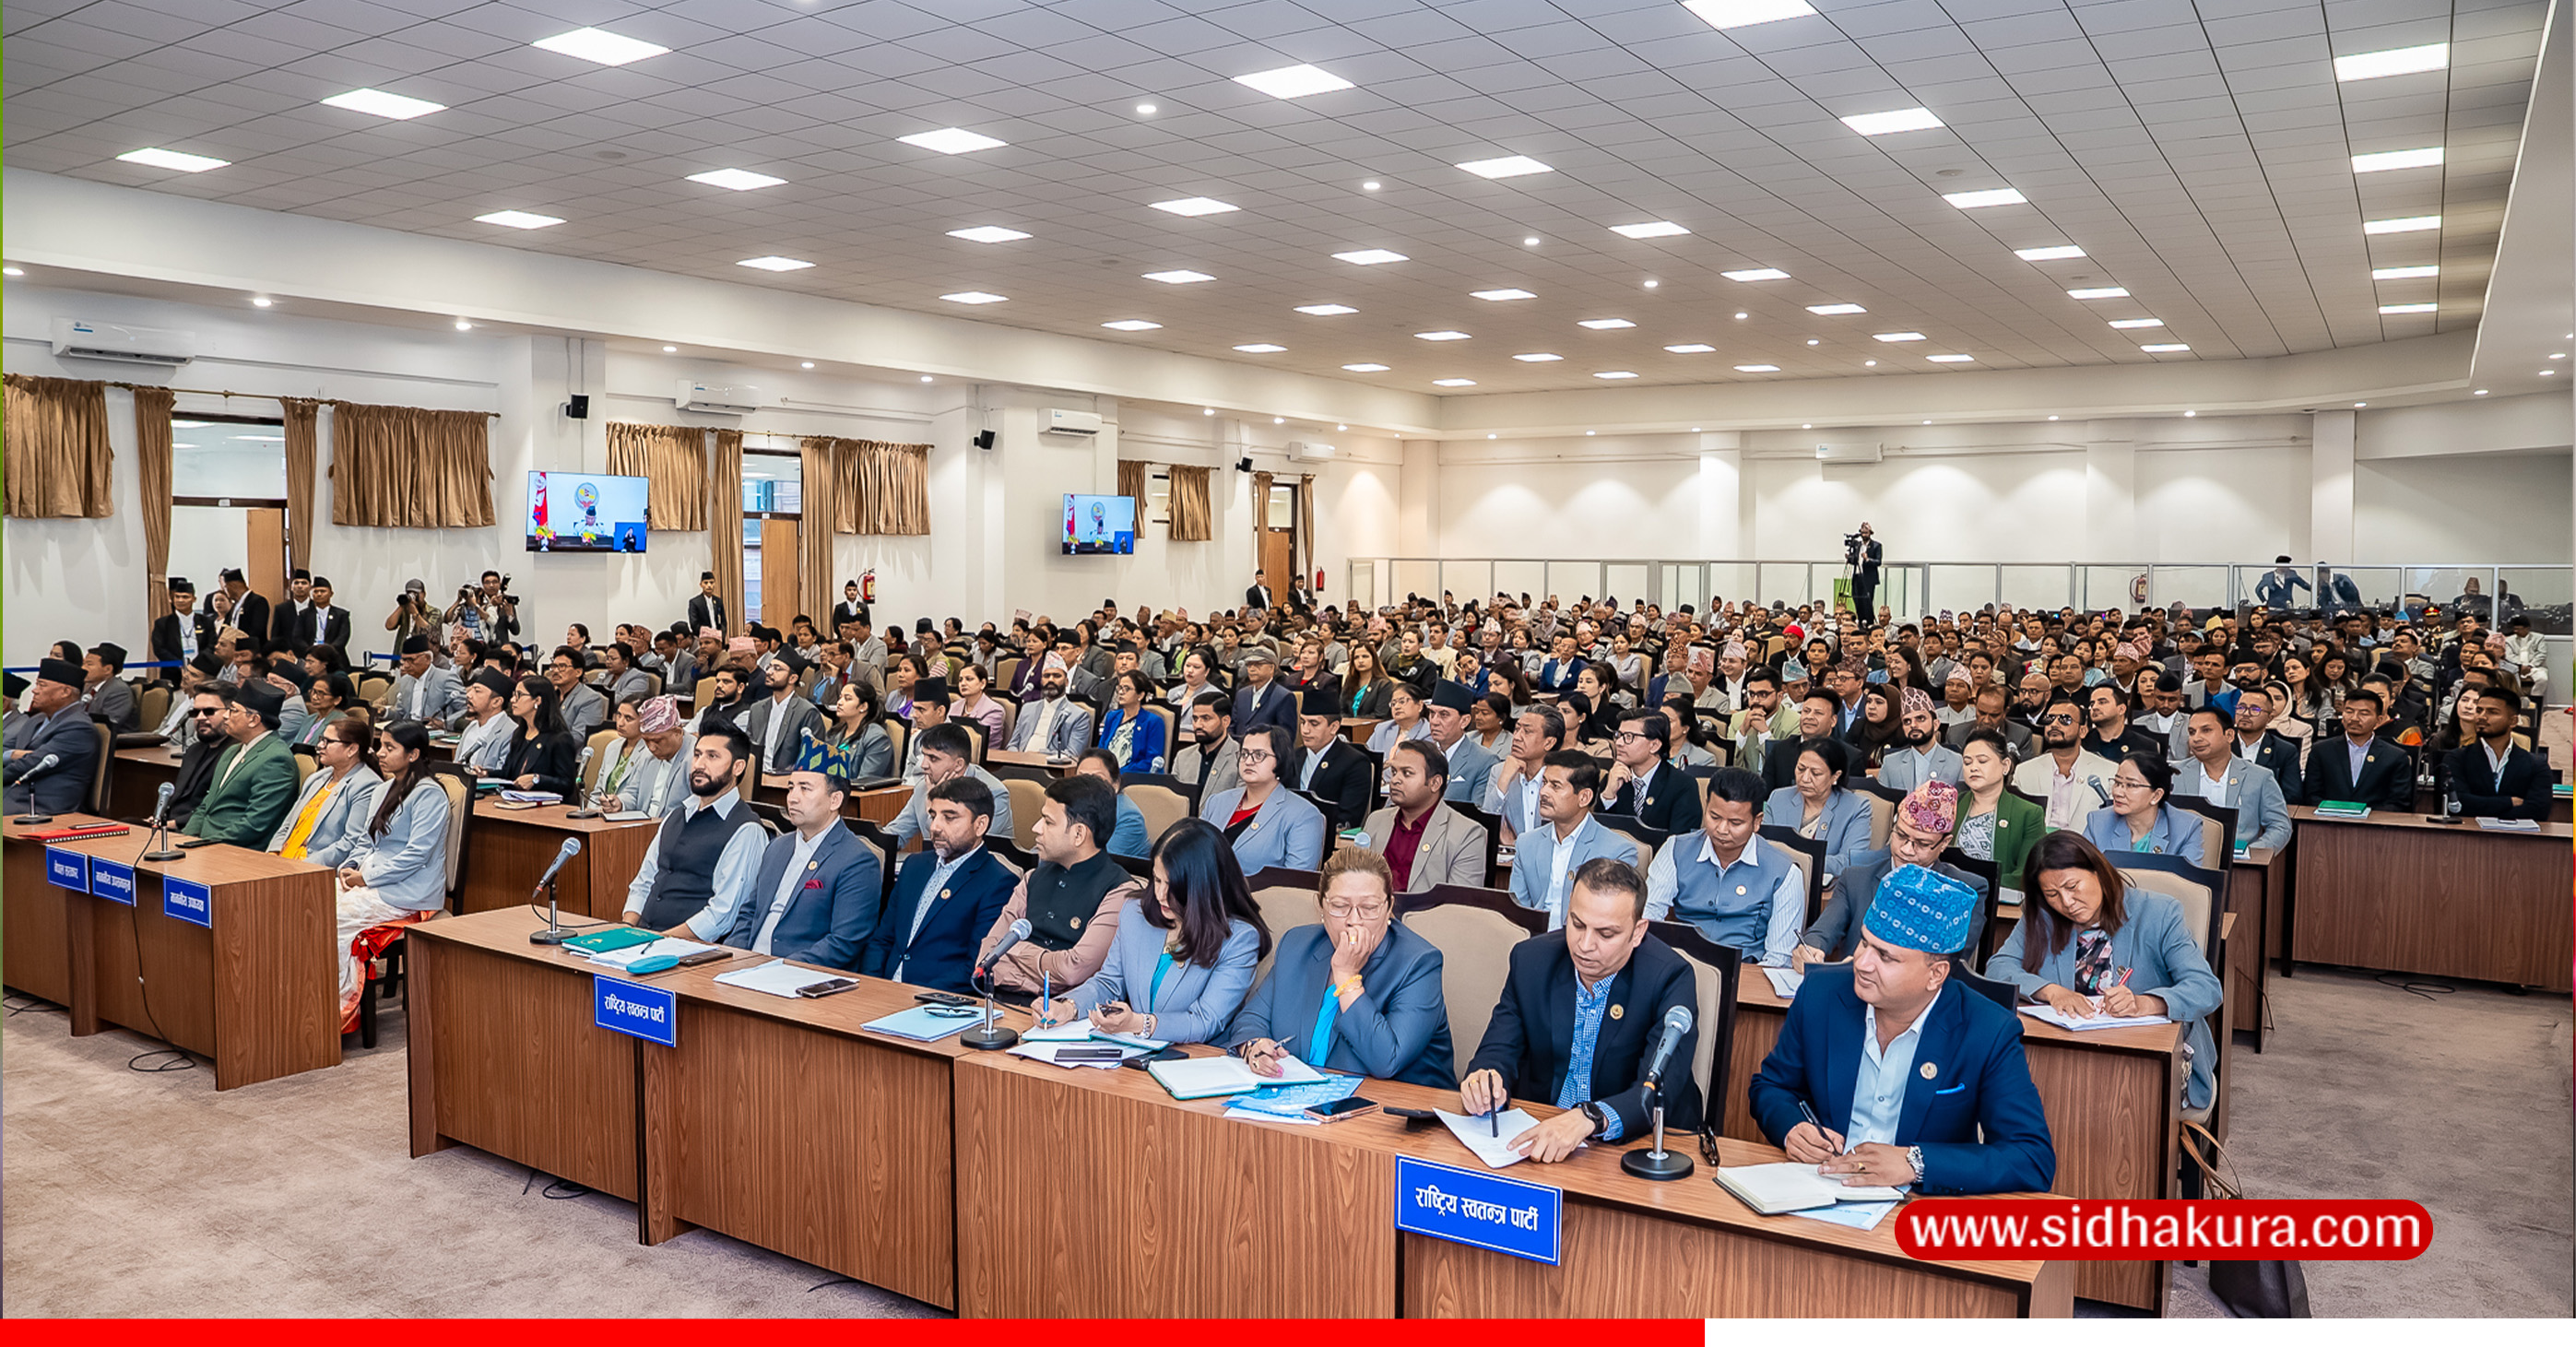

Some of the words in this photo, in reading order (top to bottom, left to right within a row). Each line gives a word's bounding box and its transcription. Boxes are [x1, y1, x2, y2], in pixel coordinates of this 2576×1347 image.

[1415, 1184, 1458, 1217] राष्ट्रिय
[1460, 1197, 1507, 1224] स्वतन्त्र
[1510, 1205, 1539, 1232] पार्टी
